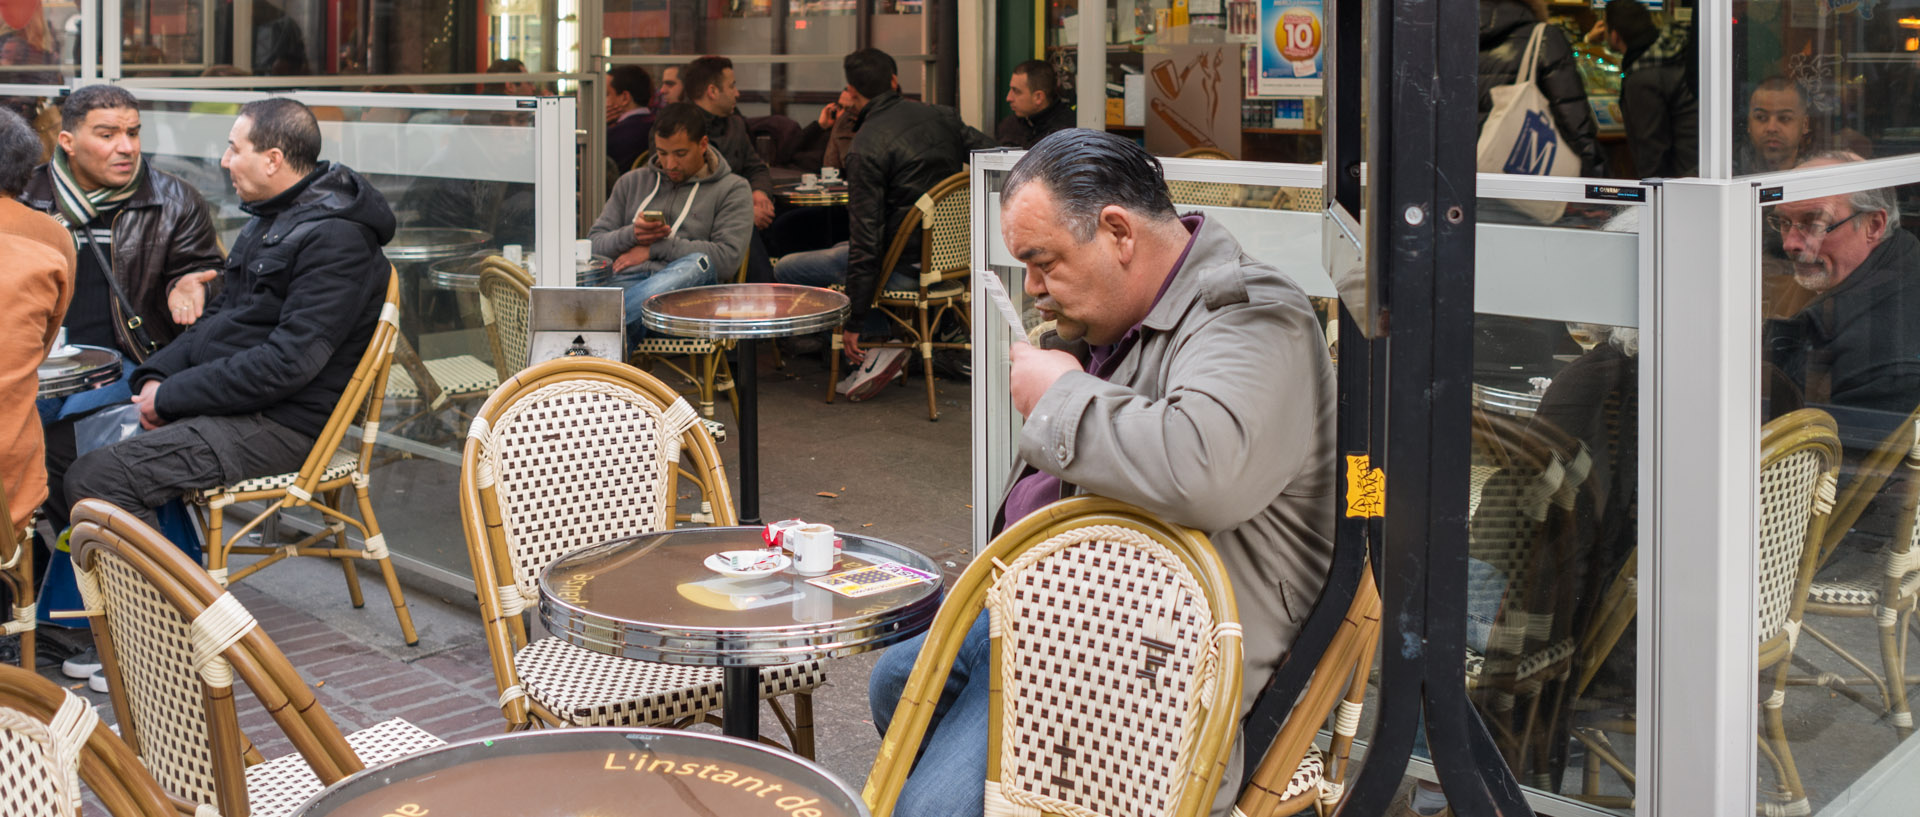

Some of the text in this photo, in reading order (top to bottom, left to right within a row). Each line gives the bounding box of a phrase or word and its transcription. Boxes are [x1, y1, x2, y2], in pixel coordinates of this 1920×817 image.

[1284, 23, 1313, 49] 10
[1516, 127, 1556, 176] M
[557, 574, 595, 604] pause
[603, 752, 823, 817] L'instant de
